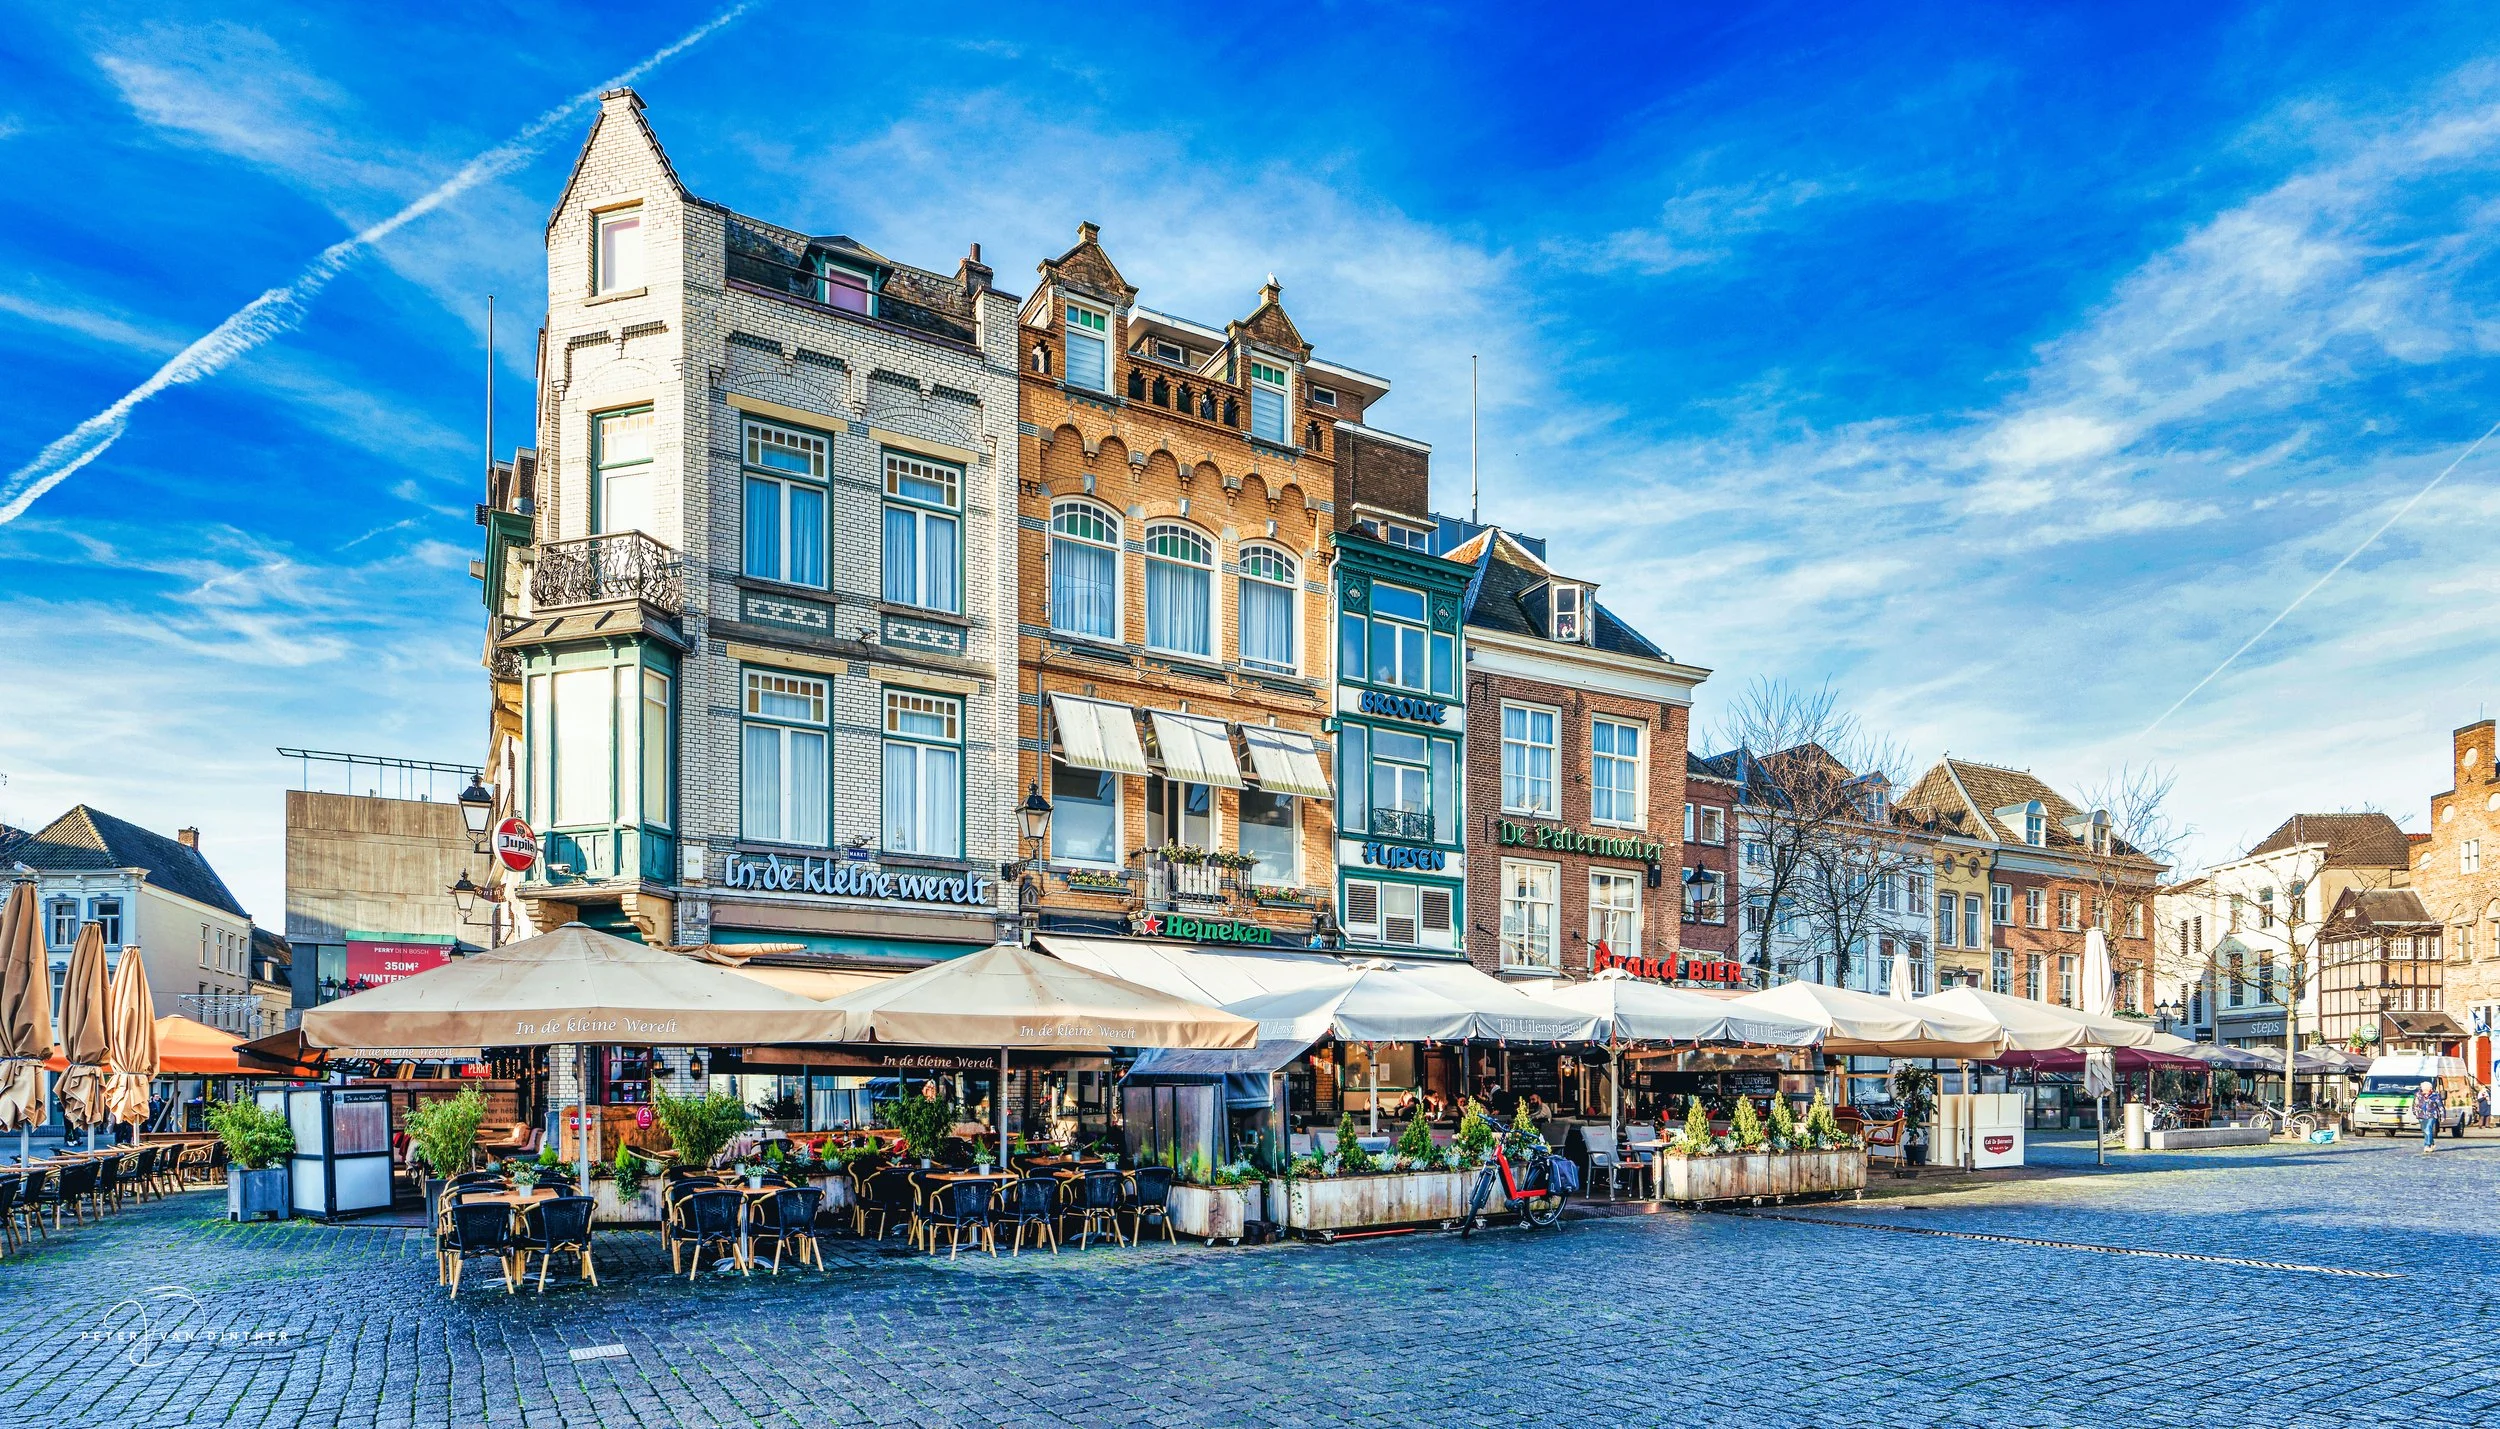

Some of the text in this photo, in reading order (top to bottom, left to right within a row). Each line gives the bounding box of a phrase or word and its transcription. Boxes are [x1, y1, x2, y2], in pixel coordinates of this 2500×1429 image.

[1360, 690, 1448, 725] BROODJE
[1498, 819, 1666, 861] De Paternoster
[1363, 841, 1446, 871] FLIPSEN
[724, 852, 995, 905] In de kleine werelt
[1165, 915, 1272, 944] Heineken
[1593, 939, 1743, 983] Brand BIER
[359, 973, 411, 983] WINTER
[515, 1016, 678, 1035] In de kleine Werelt
[1019, 1023, 1136, 1039] In de kleine Werelt
[1498, 1018, 1585, 1037] Tijl Uilenspiegel
[1743, 1022, 1811, 1043] Tijl Uilenspiegel
[2250, 1020, 2280, 1036] steps
[354, 1048, 366, 1057] In
[882, 1054, 995, 1069] In de kleine Werelt
[468, 1063, 489, 1074] PERRY
